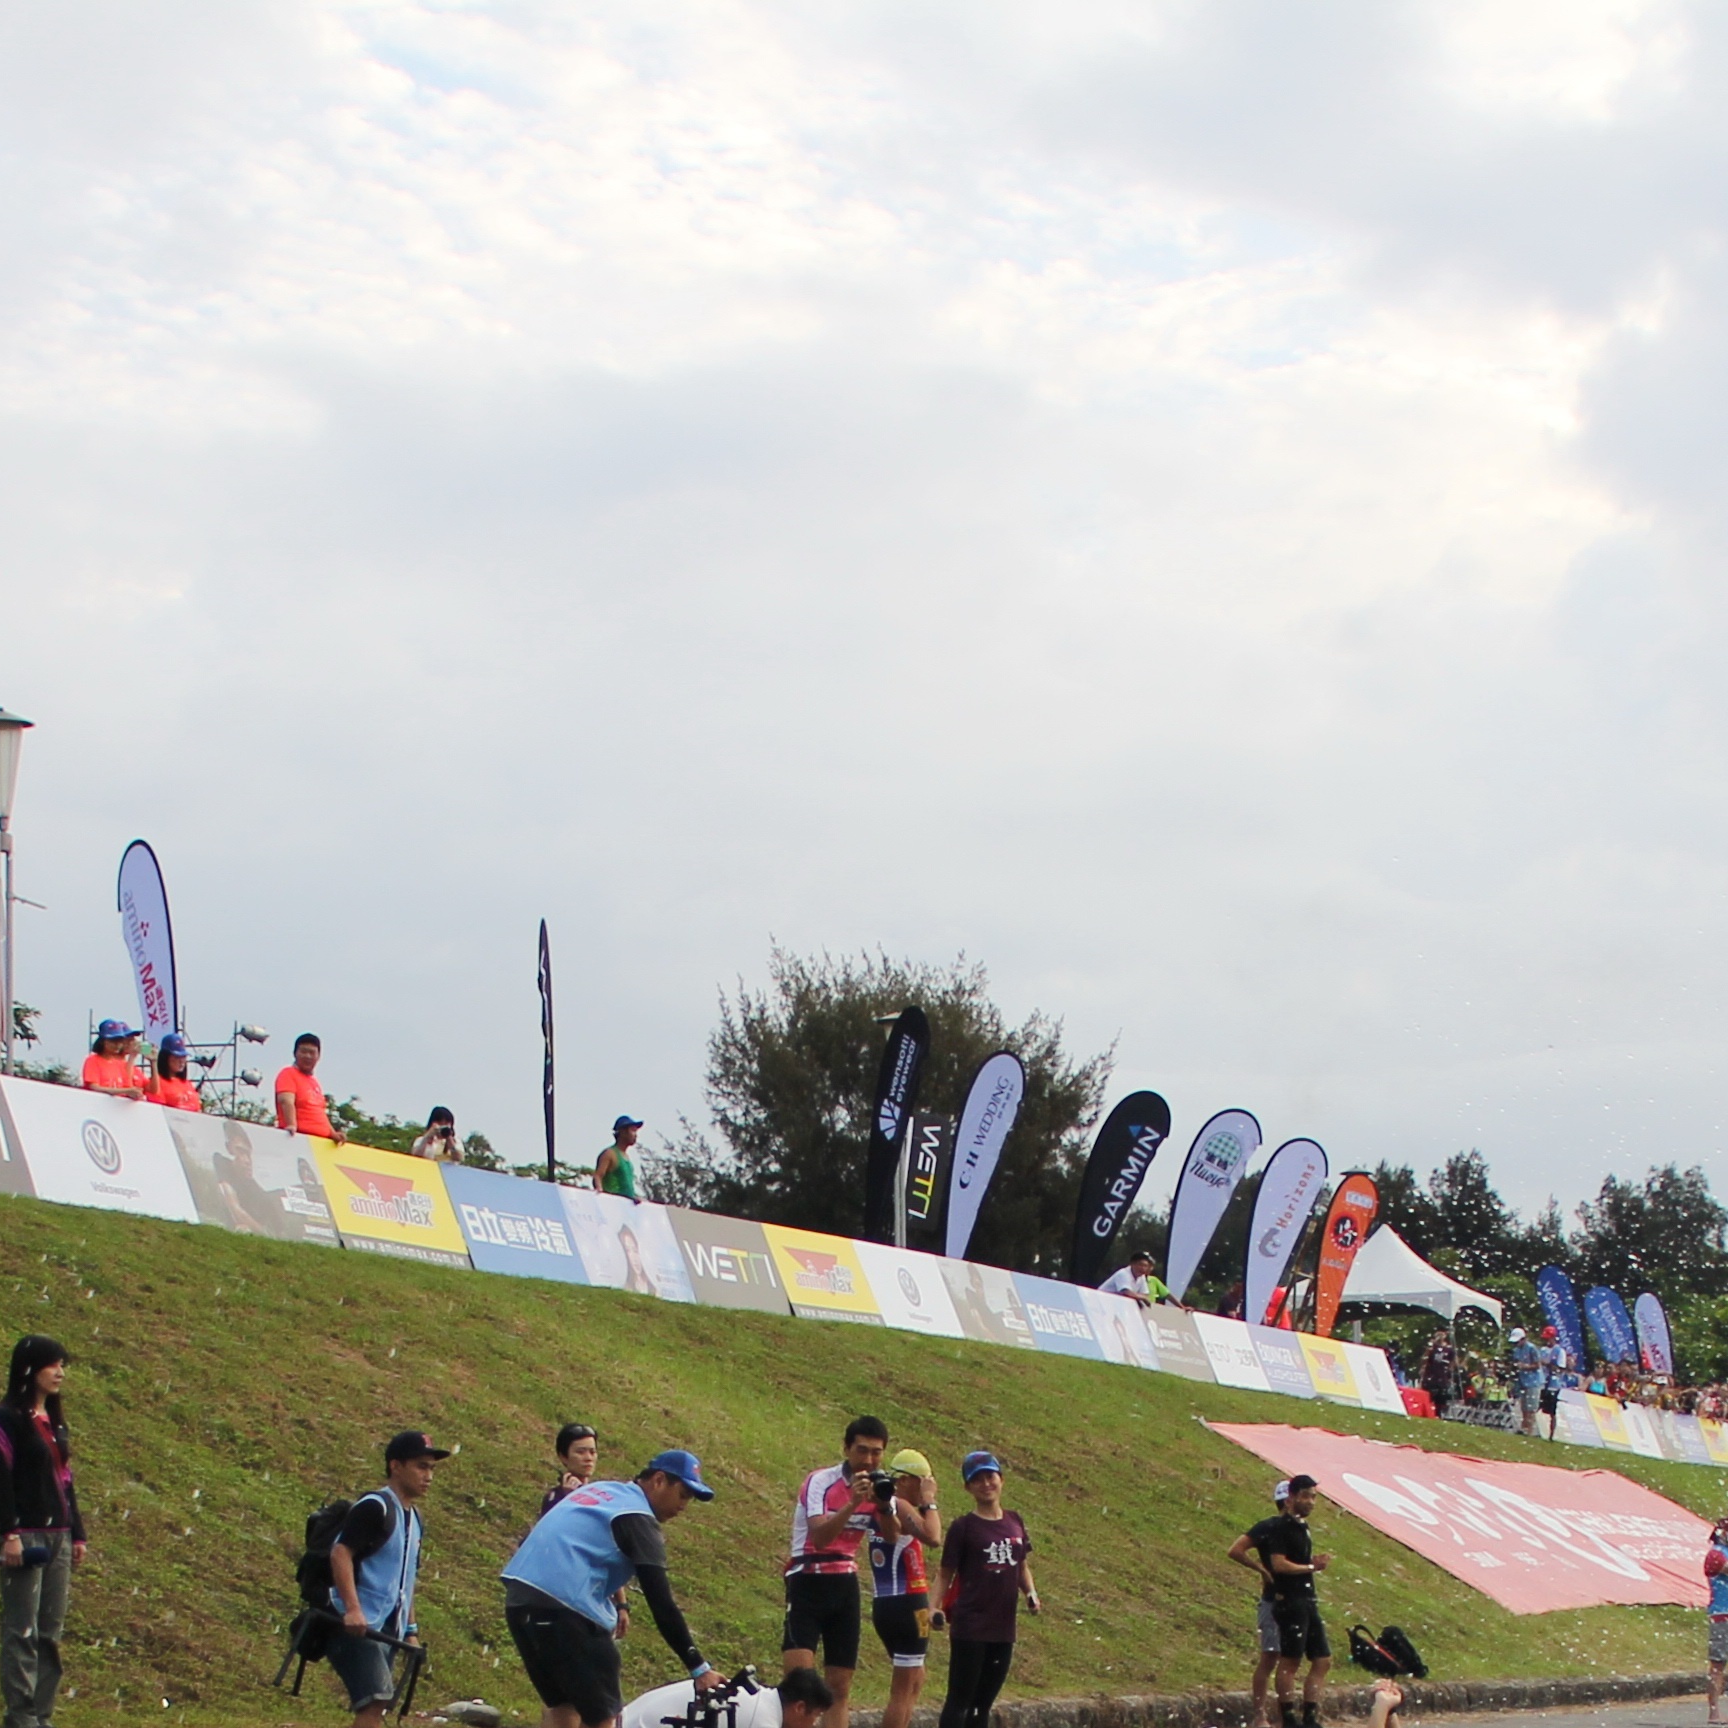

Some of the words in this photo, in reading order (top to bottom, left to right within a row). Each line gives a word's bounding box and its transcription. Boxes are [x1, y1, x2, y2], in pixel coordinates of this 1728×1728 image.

[973, 1076, 1011, 1147] WEDDING
[1092, 1126, 1161, 1238] GARMIN
[1275, 1163, 1317, 1230] Horizons
